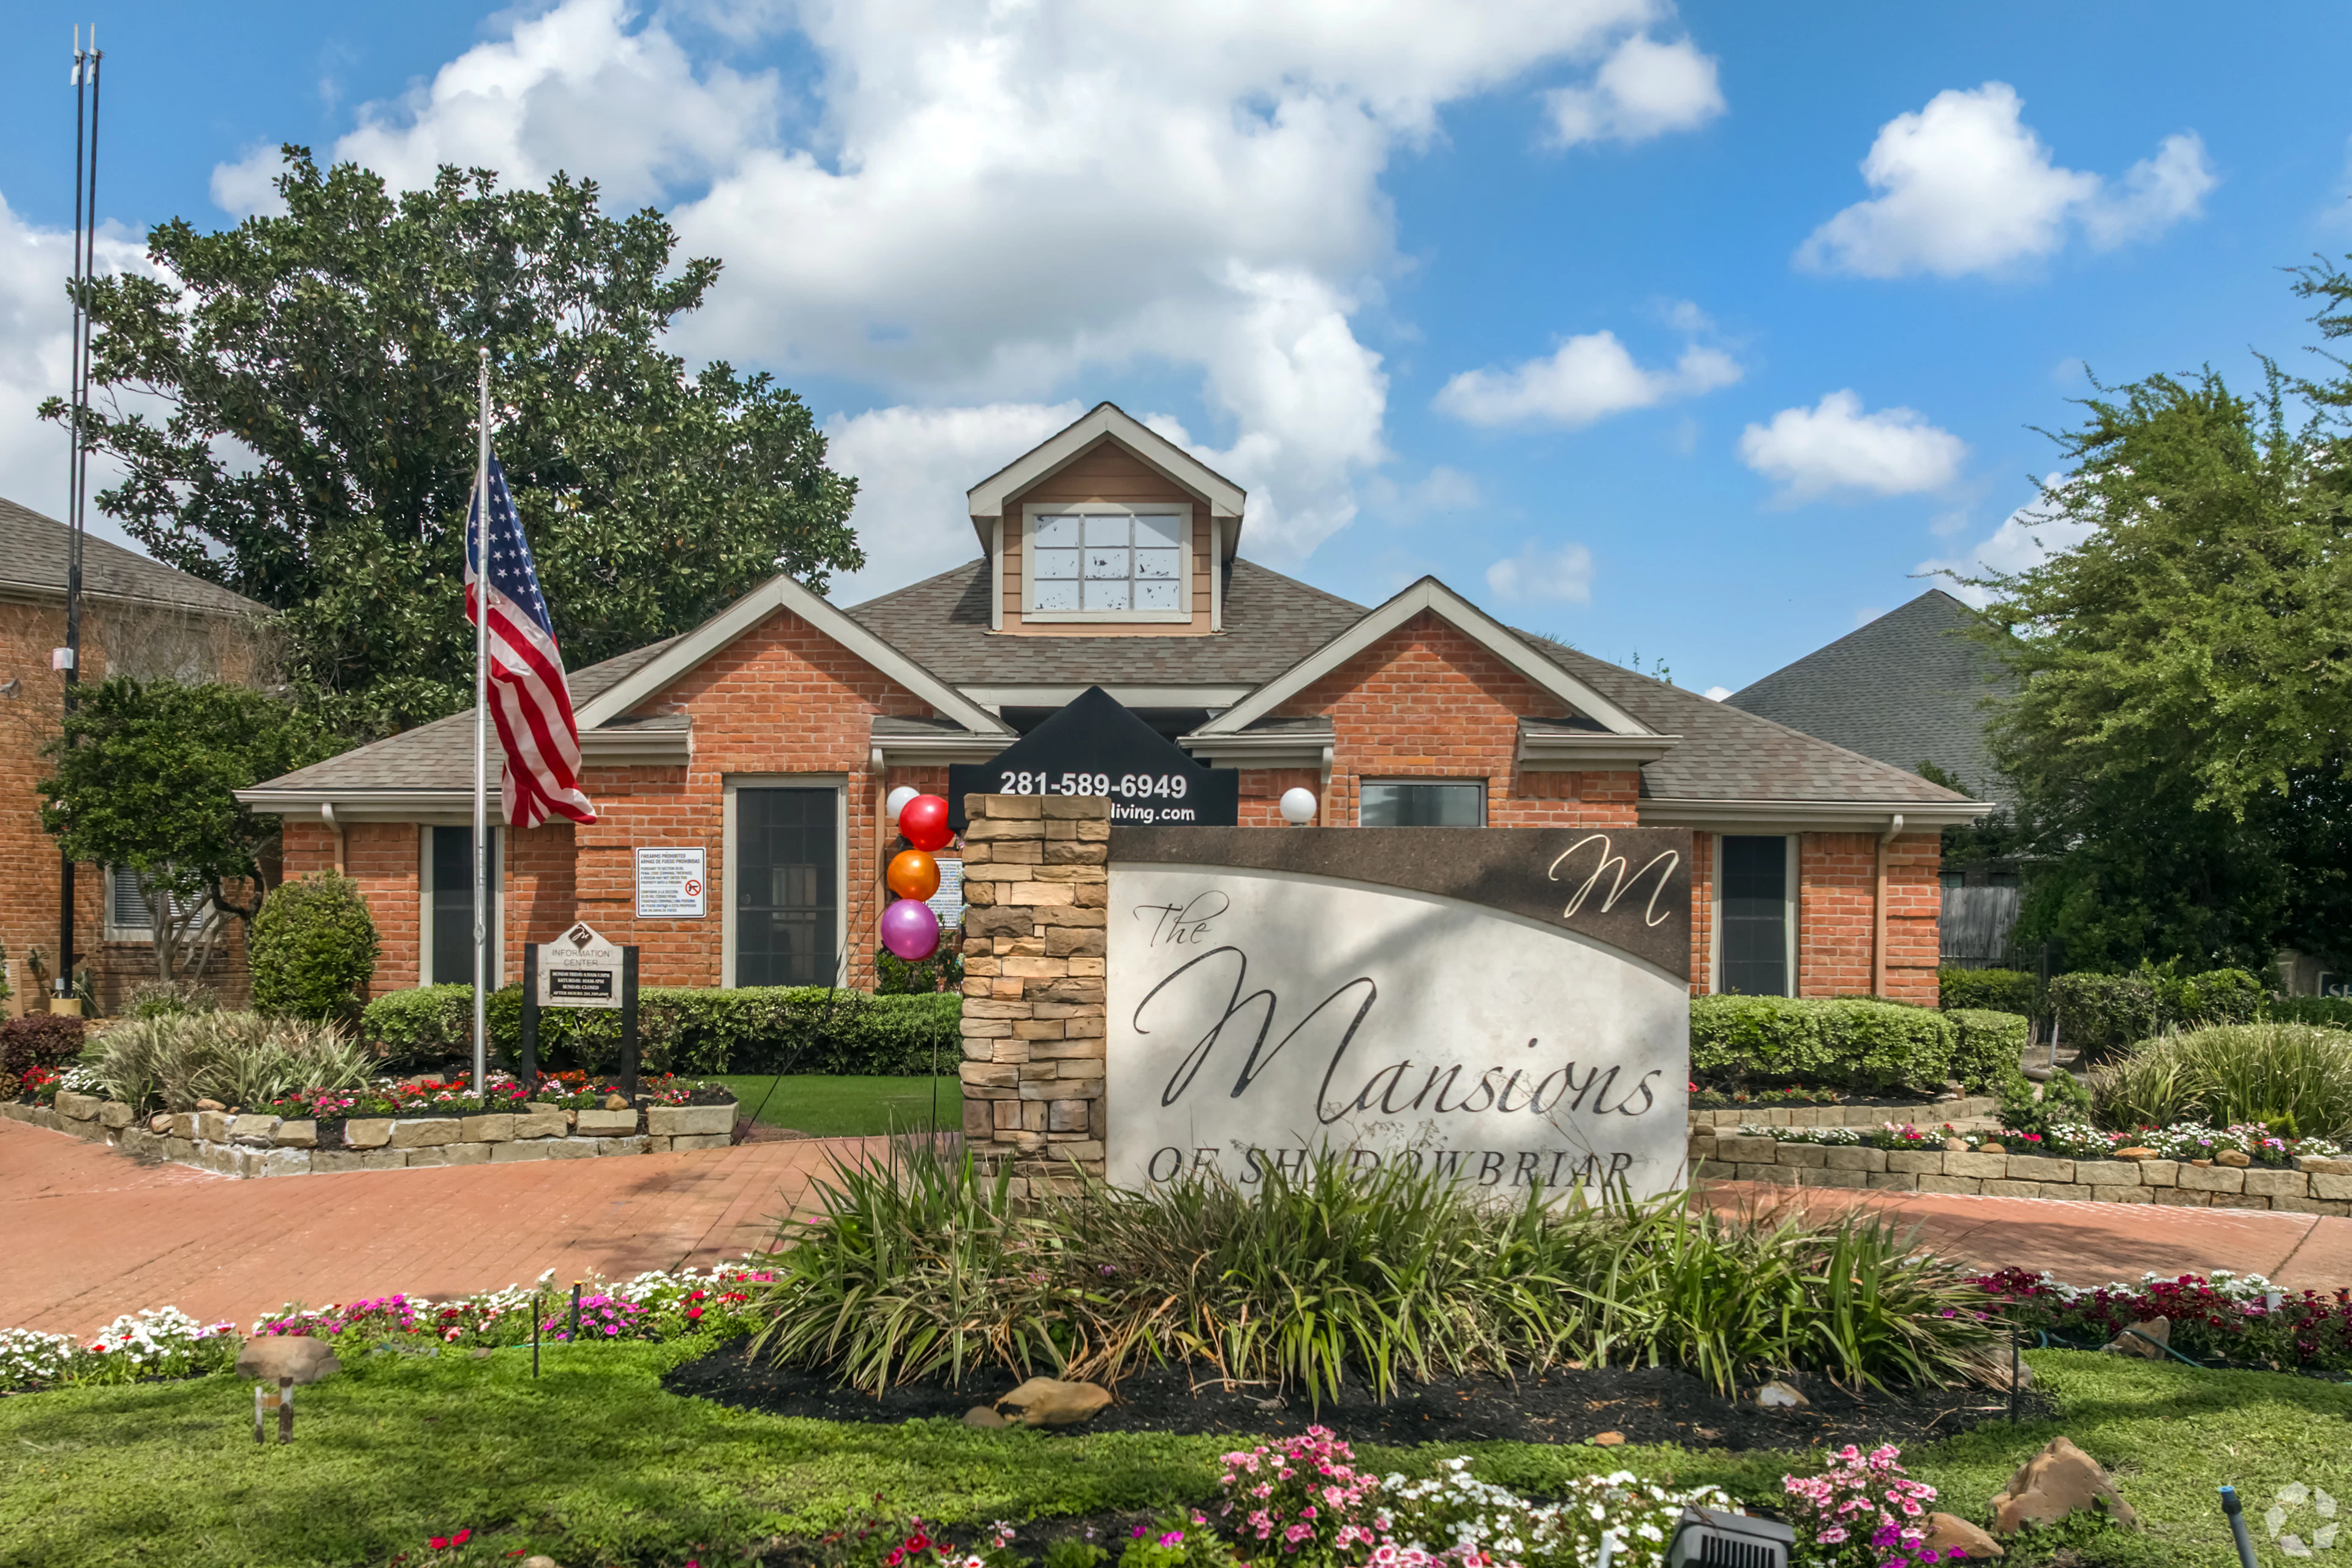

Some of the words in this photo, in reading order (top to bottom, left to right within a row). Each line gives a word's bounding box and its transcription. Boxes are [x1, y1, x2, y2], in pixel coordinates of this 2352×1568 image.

[1000, 771, 1187, 798] 281-589-6949
[1133, 891, 1229, 947] The
[552, 949, 610, 957] INFORMATION
[1133, 945, 1662, 1125] Mansions
[1148, 1147, 1219, 1183] OF
